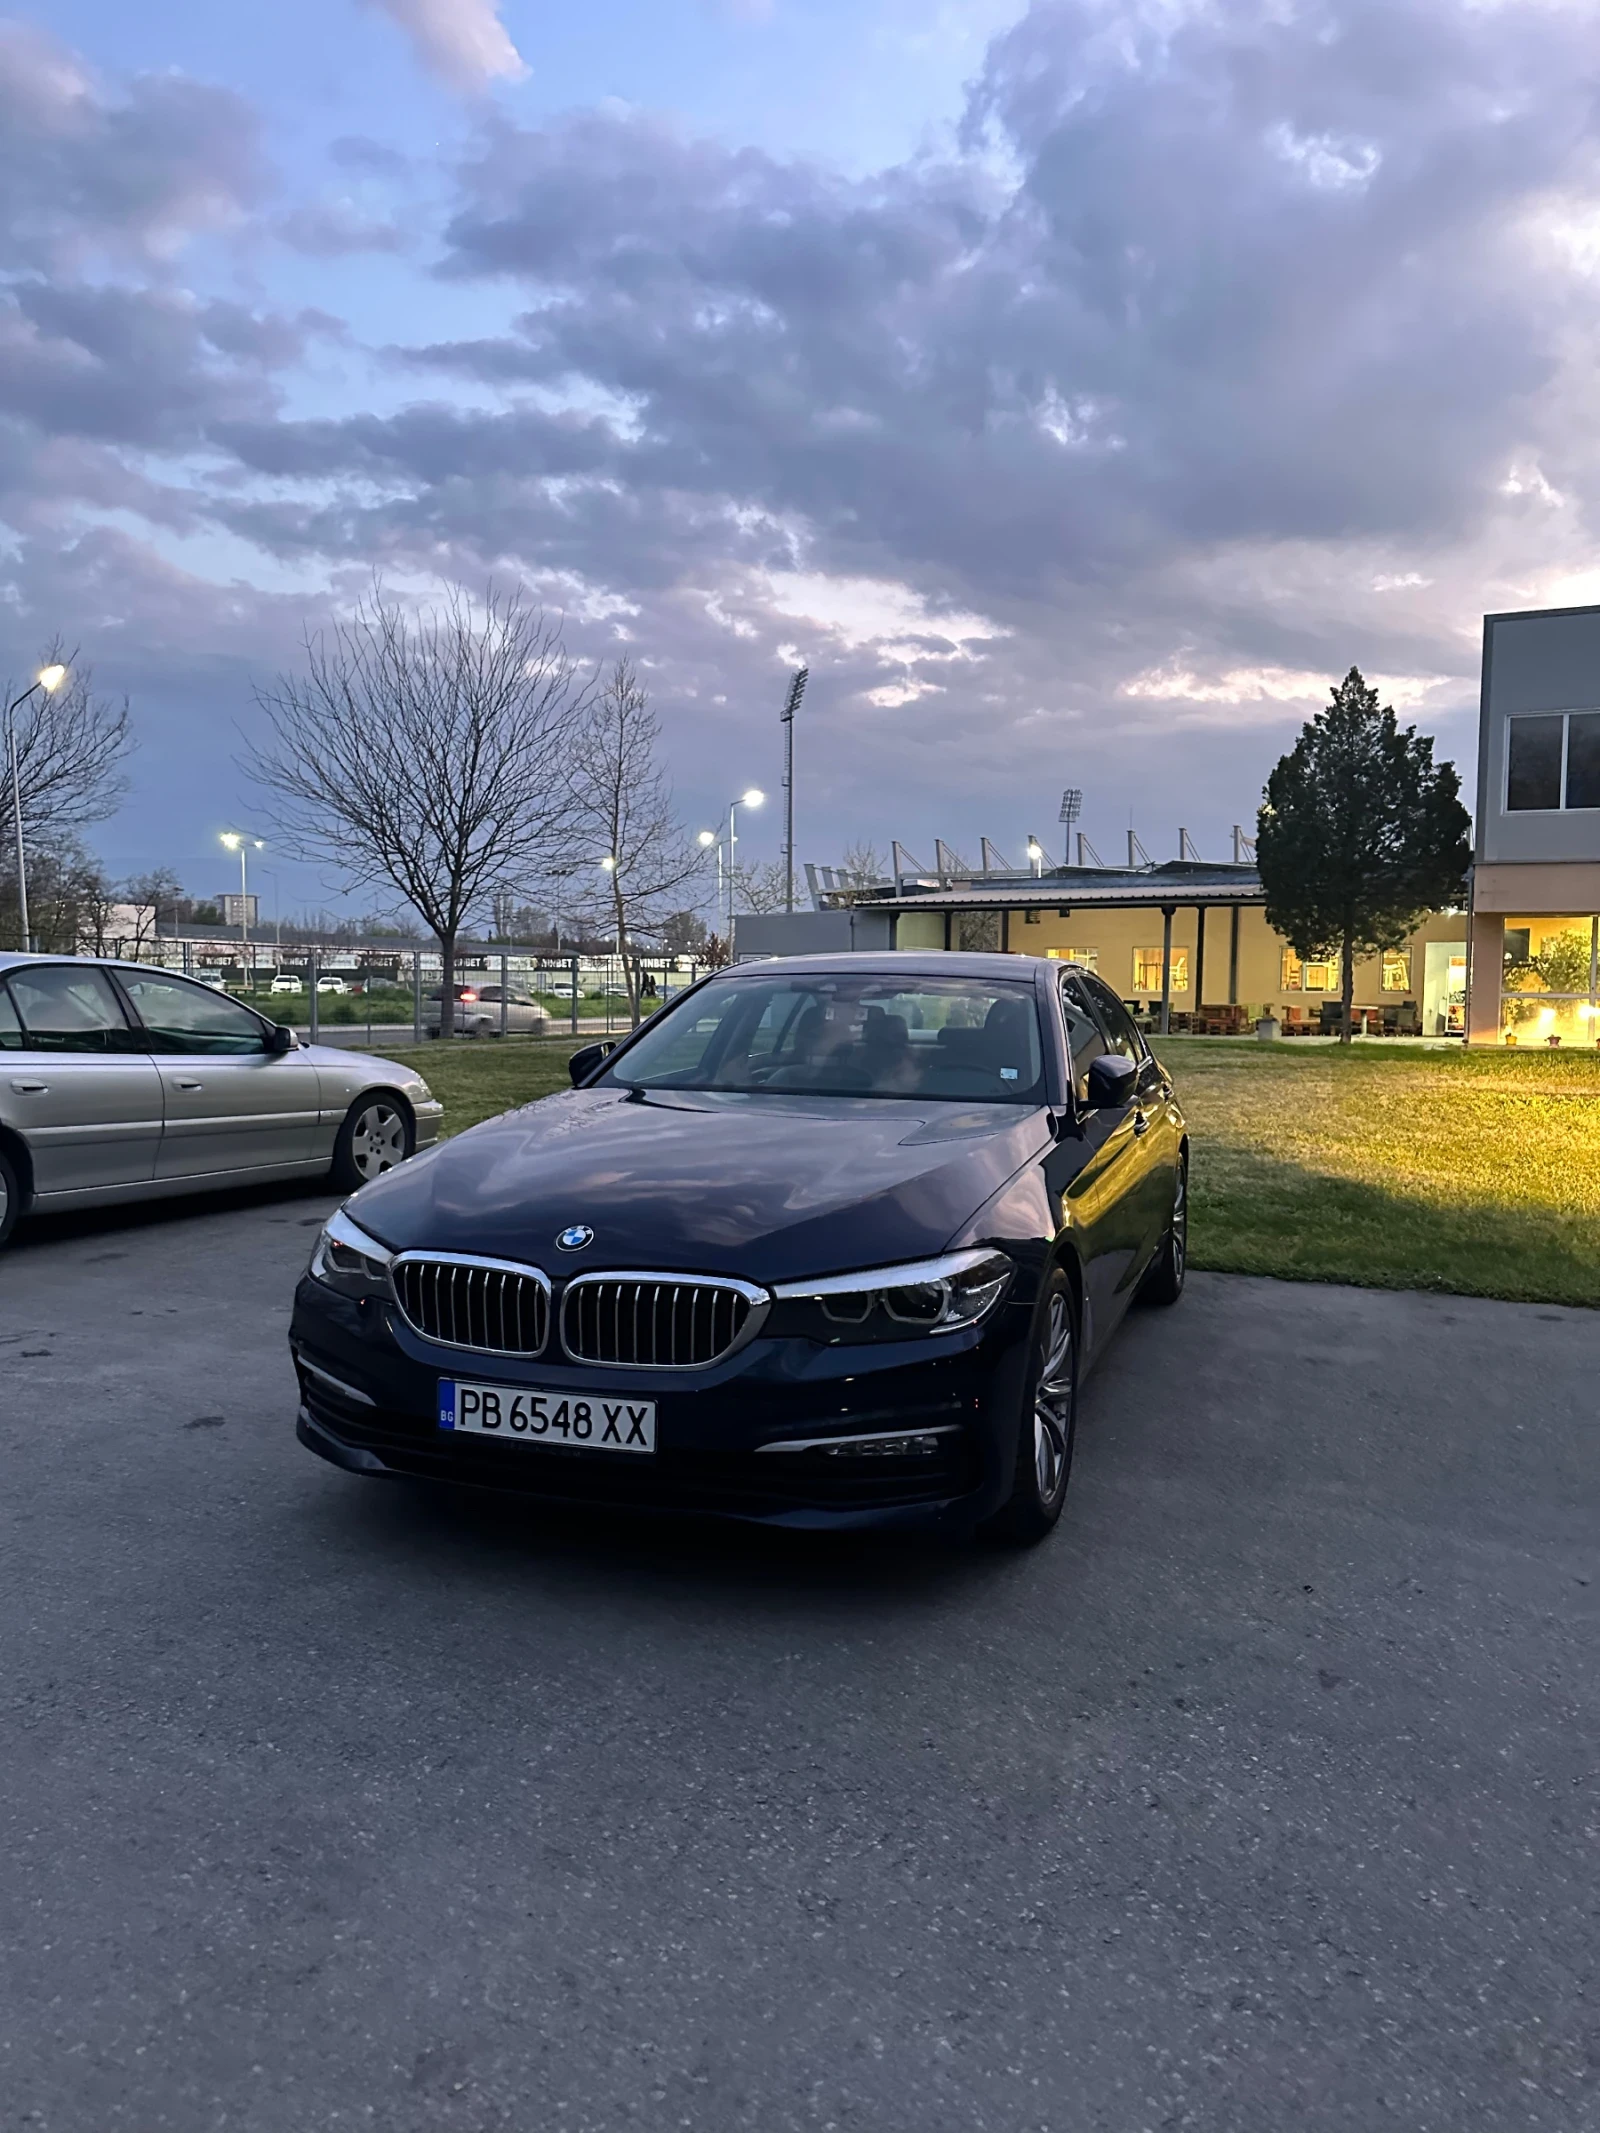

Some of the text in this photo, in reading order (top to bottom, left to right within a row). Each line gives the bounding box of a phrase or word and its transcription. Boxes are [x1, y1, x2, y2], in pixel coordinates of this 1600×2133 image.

[440, 1410, 454, 1423] BG
[460, 1388, 648, 1446] PB 6548 XX
